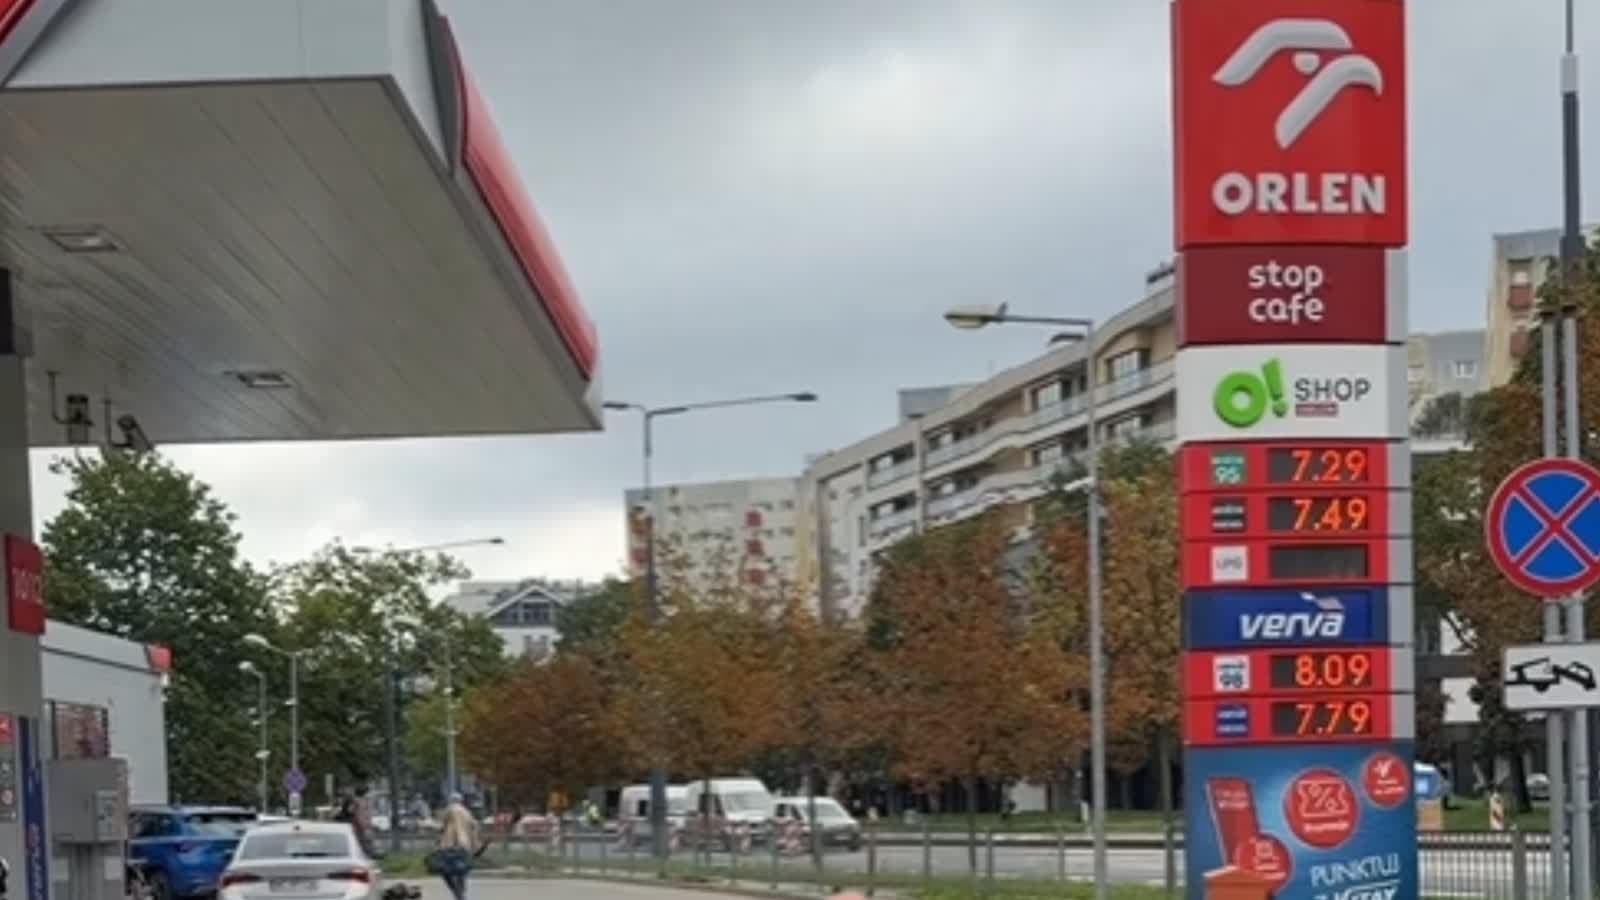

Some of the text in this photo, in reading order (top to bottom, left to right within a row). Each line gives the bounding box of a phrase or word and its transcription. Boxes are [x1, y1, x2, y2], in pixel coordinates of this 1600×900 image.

[1212, 172, 1385, 214] ORLEN
[1249, 262, 1324, 296] stop
[1249, 295, 1324, 324] cafe
[1295, 378, 1371, 401] SHOP
[1291, 450, 1366, 481] 7.29
[1292, 499, 1367, 530] 7.49
[1240, 612, 1344, 639] verva
[1295, 655, 1370, 686] 8.09
[1296, 704, 1370, 734] 7.79
